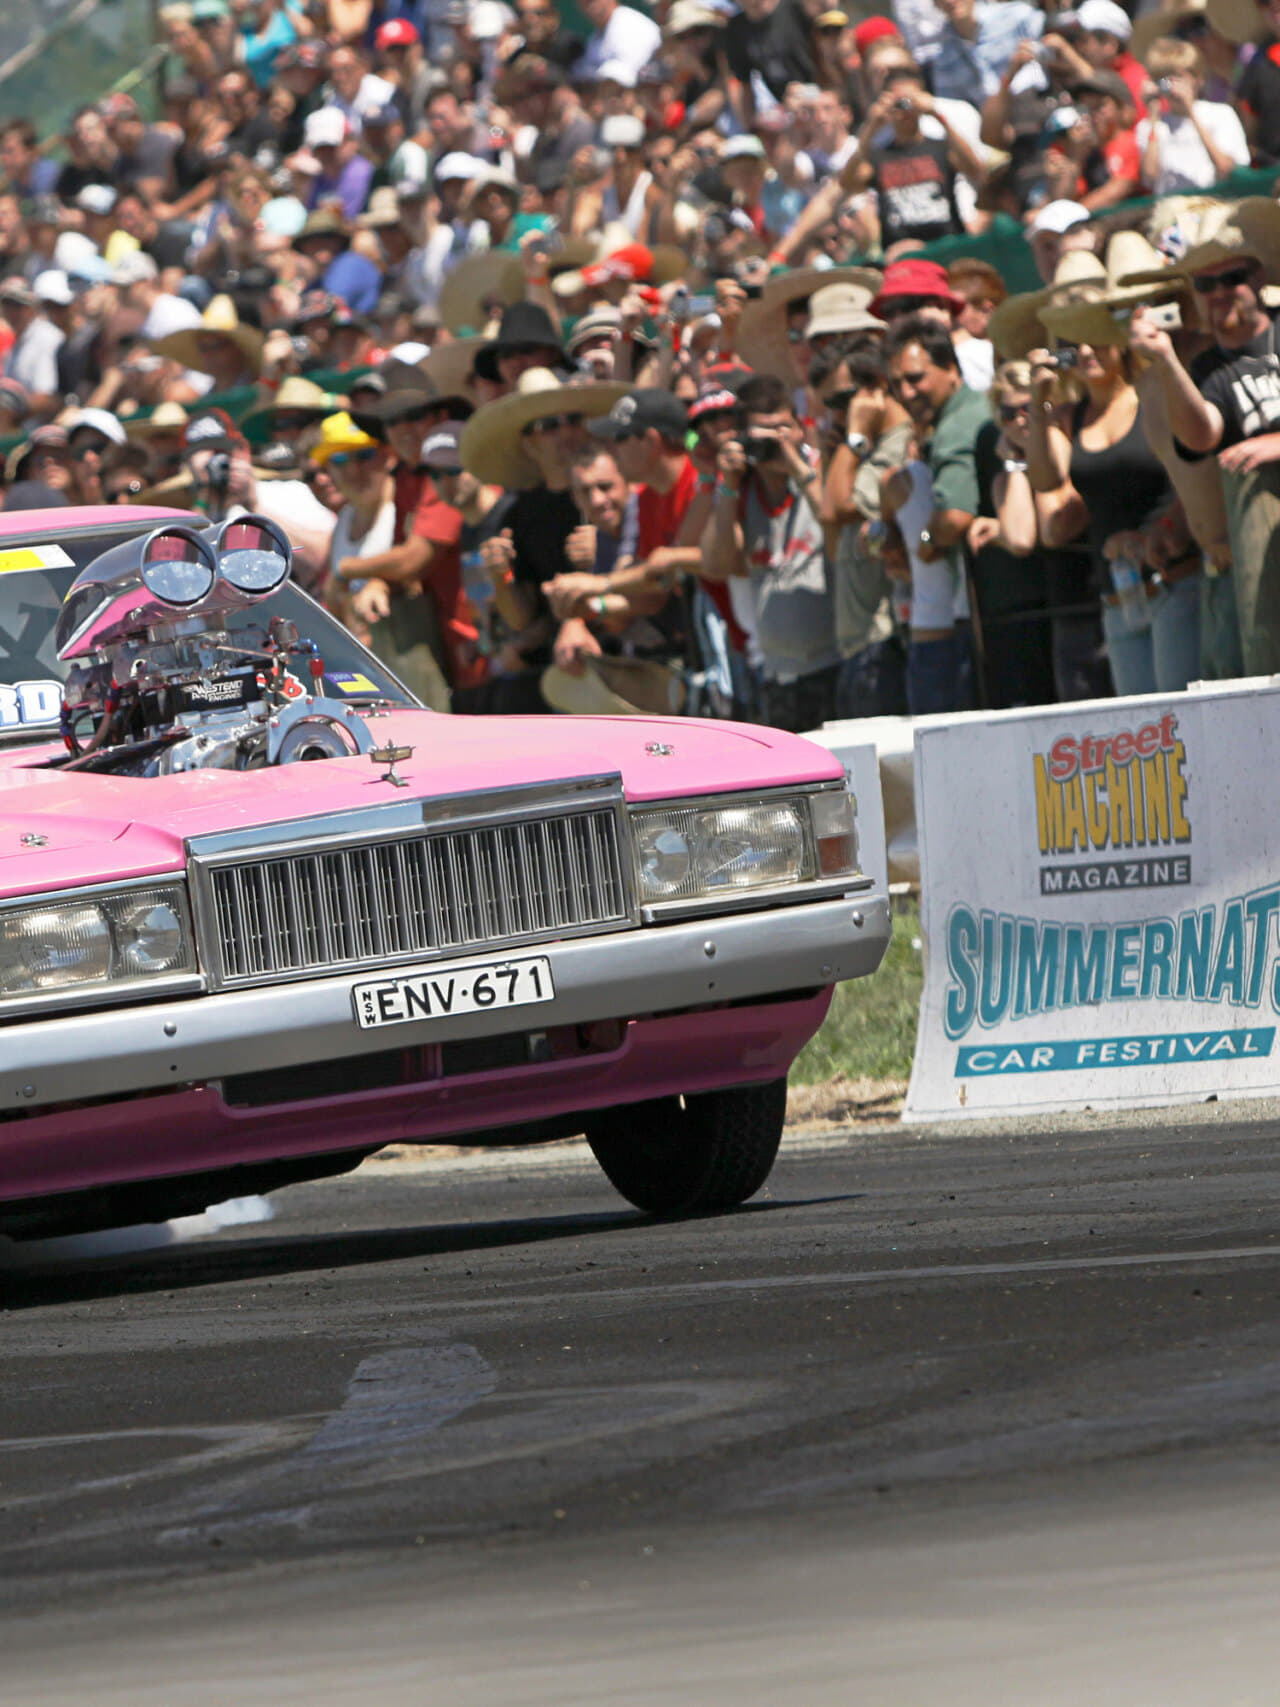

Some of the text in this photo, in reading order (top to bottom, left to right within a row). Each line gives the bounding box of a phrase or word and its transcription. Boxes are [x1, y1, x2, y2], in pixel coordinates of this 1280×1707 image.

[1048, 711, 1179, 780] Street
[1032, 740, 1192, 855] MACHINE
[1043, 860, 1190, 892] MAGAZINE
[943, 880, 1280, 1041] SUMMERNAT
[966, 1027, 1260, 1073] CAR FESTIVAL
